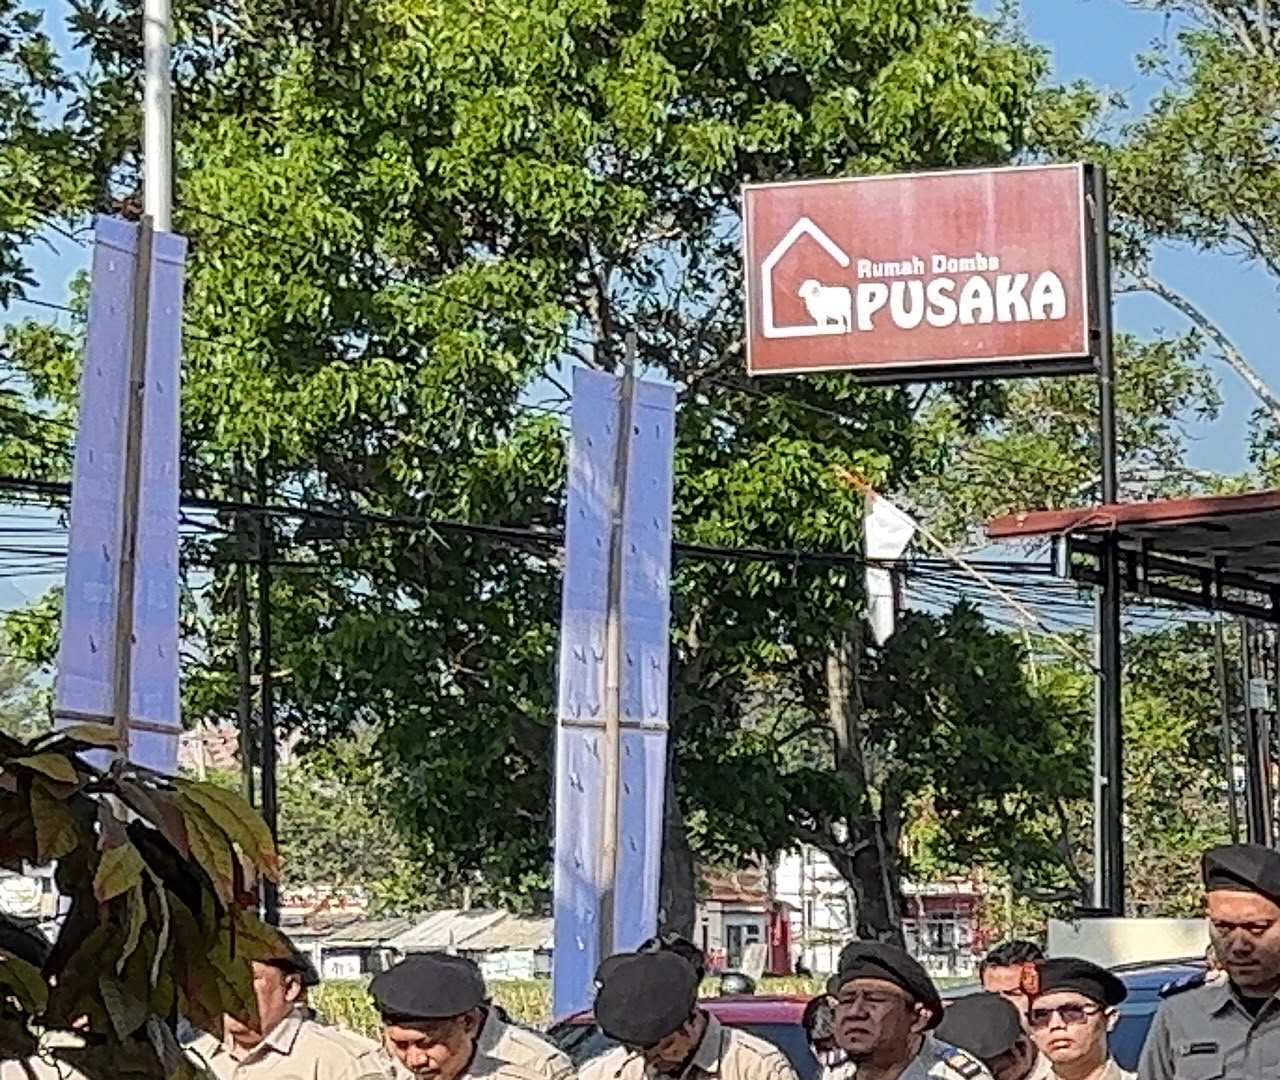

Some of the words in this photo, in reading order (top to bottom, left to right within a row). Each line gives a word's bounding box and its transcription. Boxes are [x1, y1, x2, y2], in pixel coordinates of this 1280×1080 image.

[858, 257, 925, 278] Rumah
[932, 253, 999, 273] Domba
[858, 271, 1066, 331] PUSAKA
